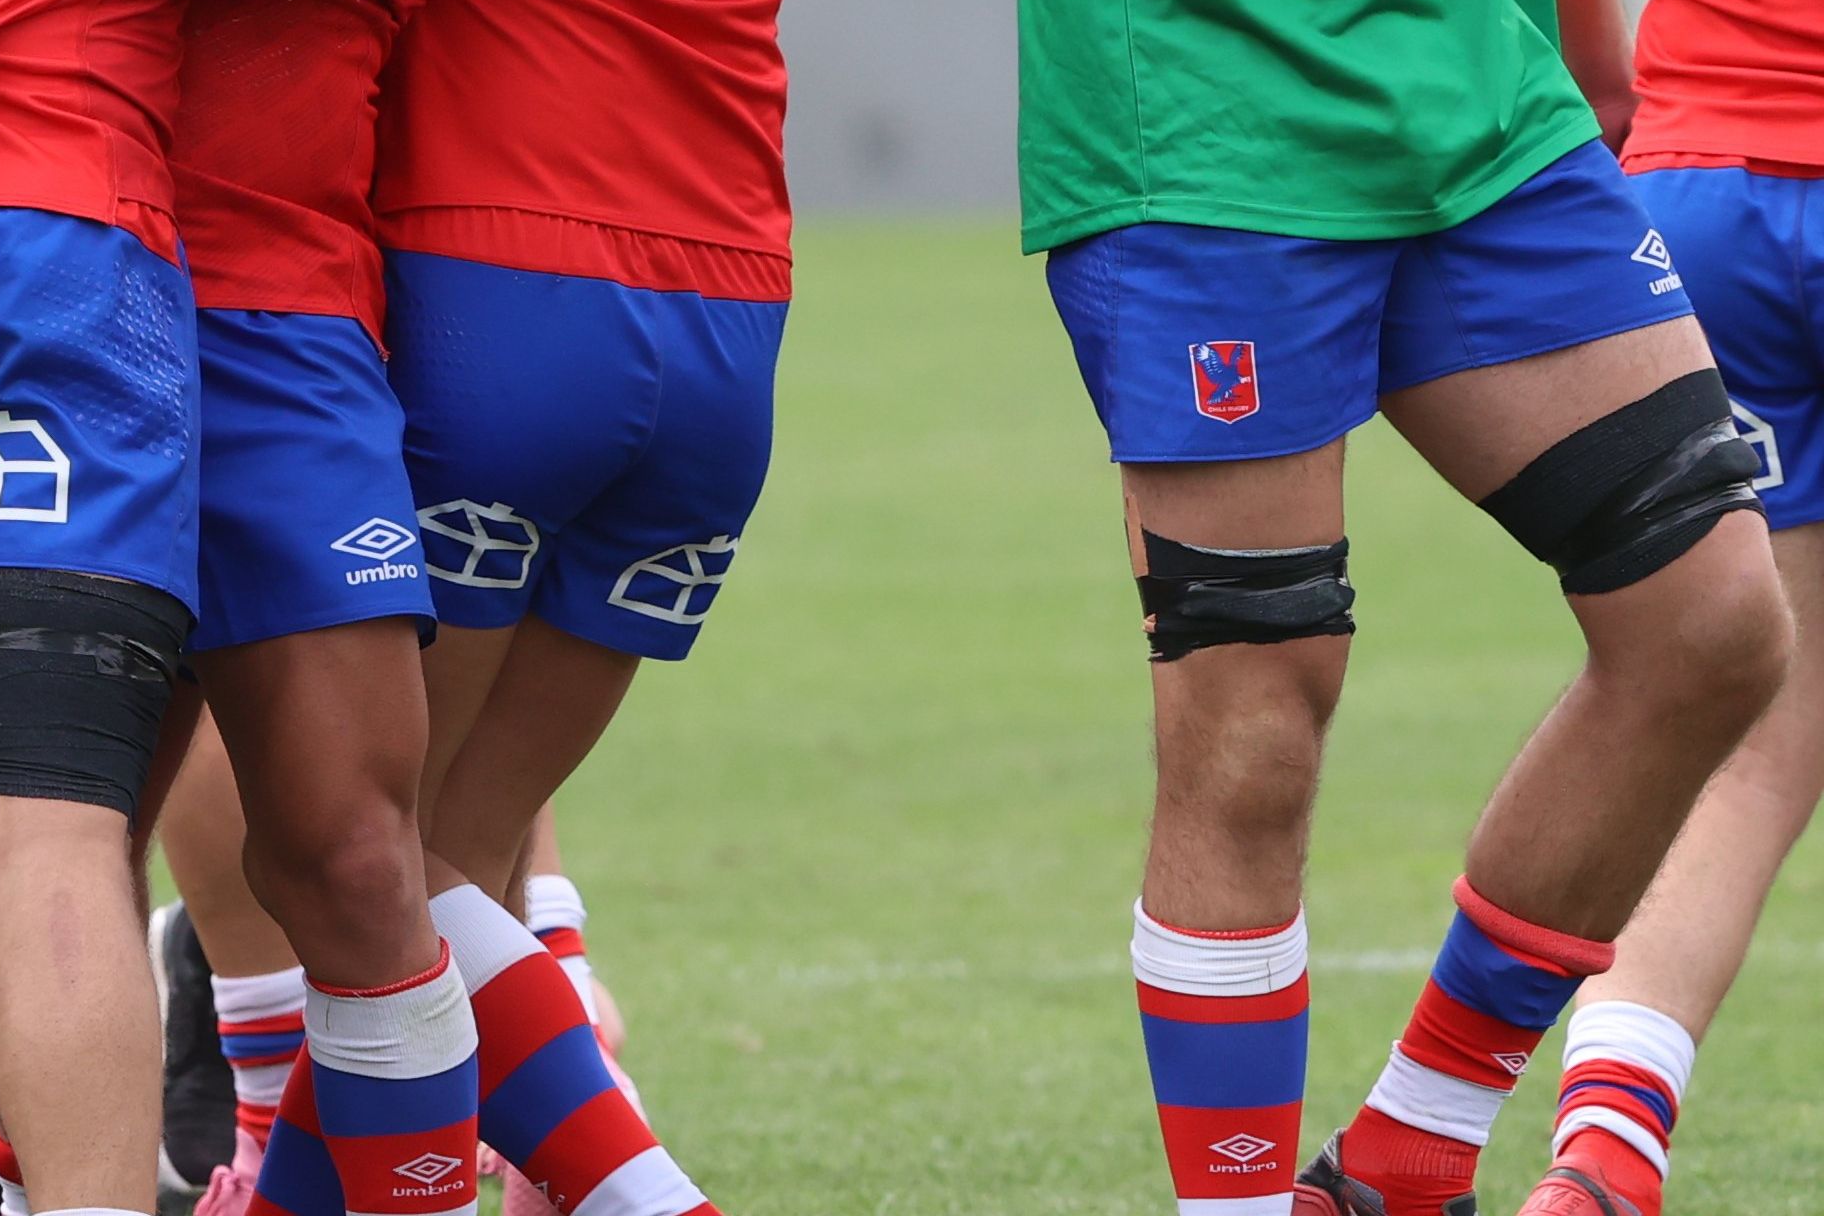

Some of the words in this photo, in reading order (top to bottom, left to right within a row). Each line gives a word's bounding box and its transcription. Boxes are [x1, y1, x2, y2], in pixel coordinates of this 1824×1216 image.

[345, 561, 418, 585] umbro
[1209, 1161, 1277, 1174] umbro
[392, 1180, 465, 1197] umbro
